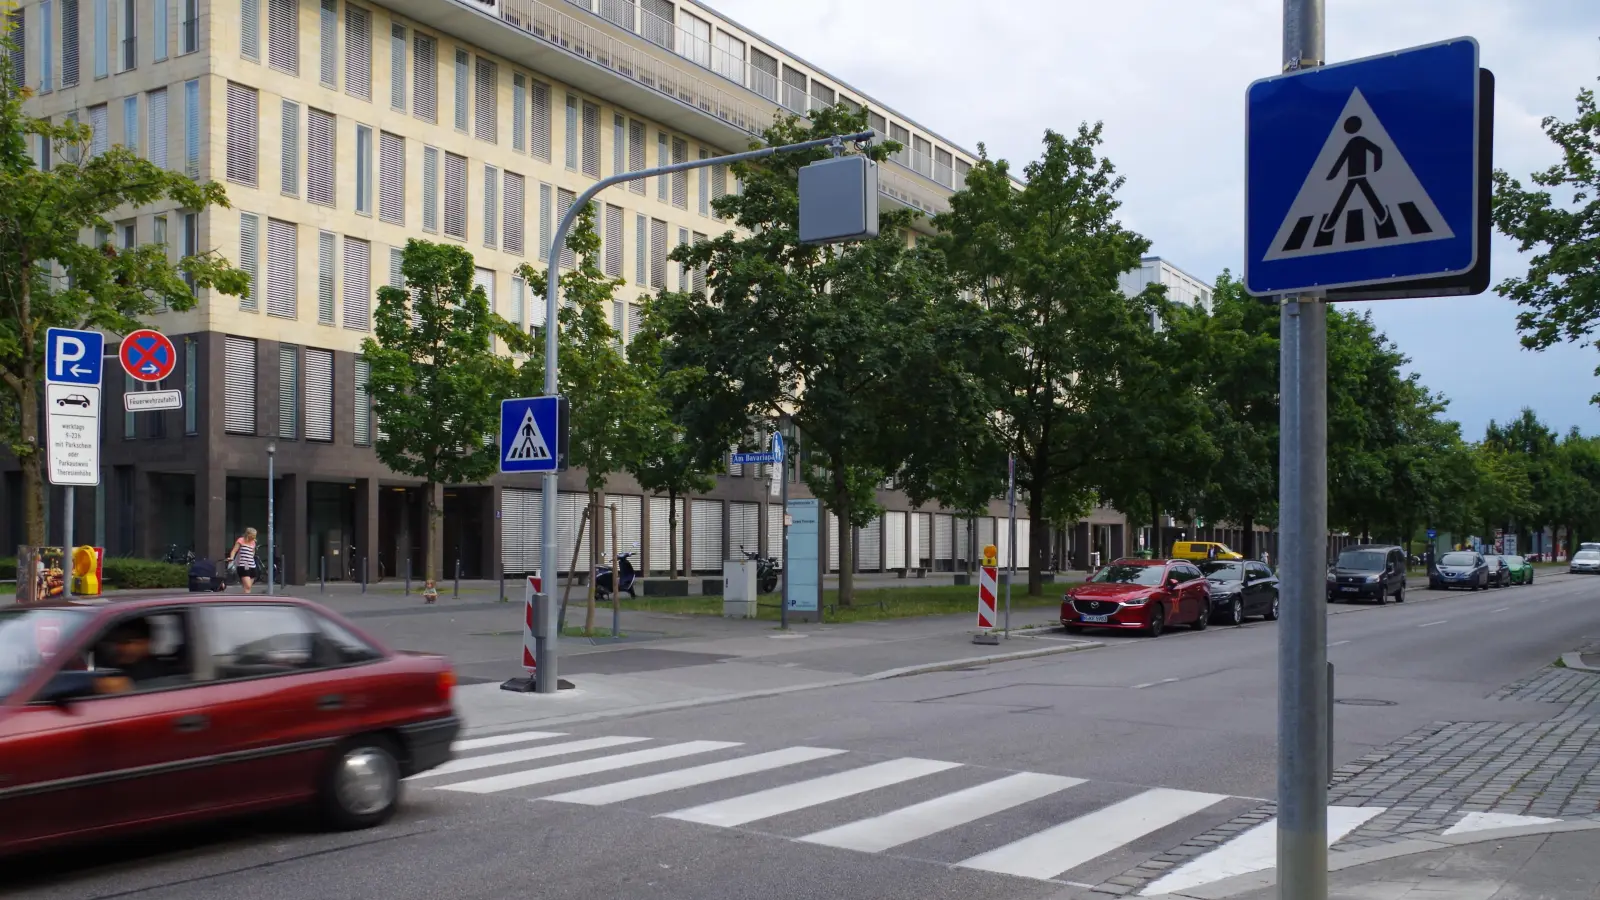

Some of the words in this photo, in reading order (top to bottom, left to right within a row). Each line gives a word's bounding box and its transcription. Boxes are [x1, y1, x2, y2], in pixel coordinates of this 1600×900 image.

[55, 336, 85, 375] P
[65, 441, 92, 449] Parkschein
[733, 455, 744, 463] Am
